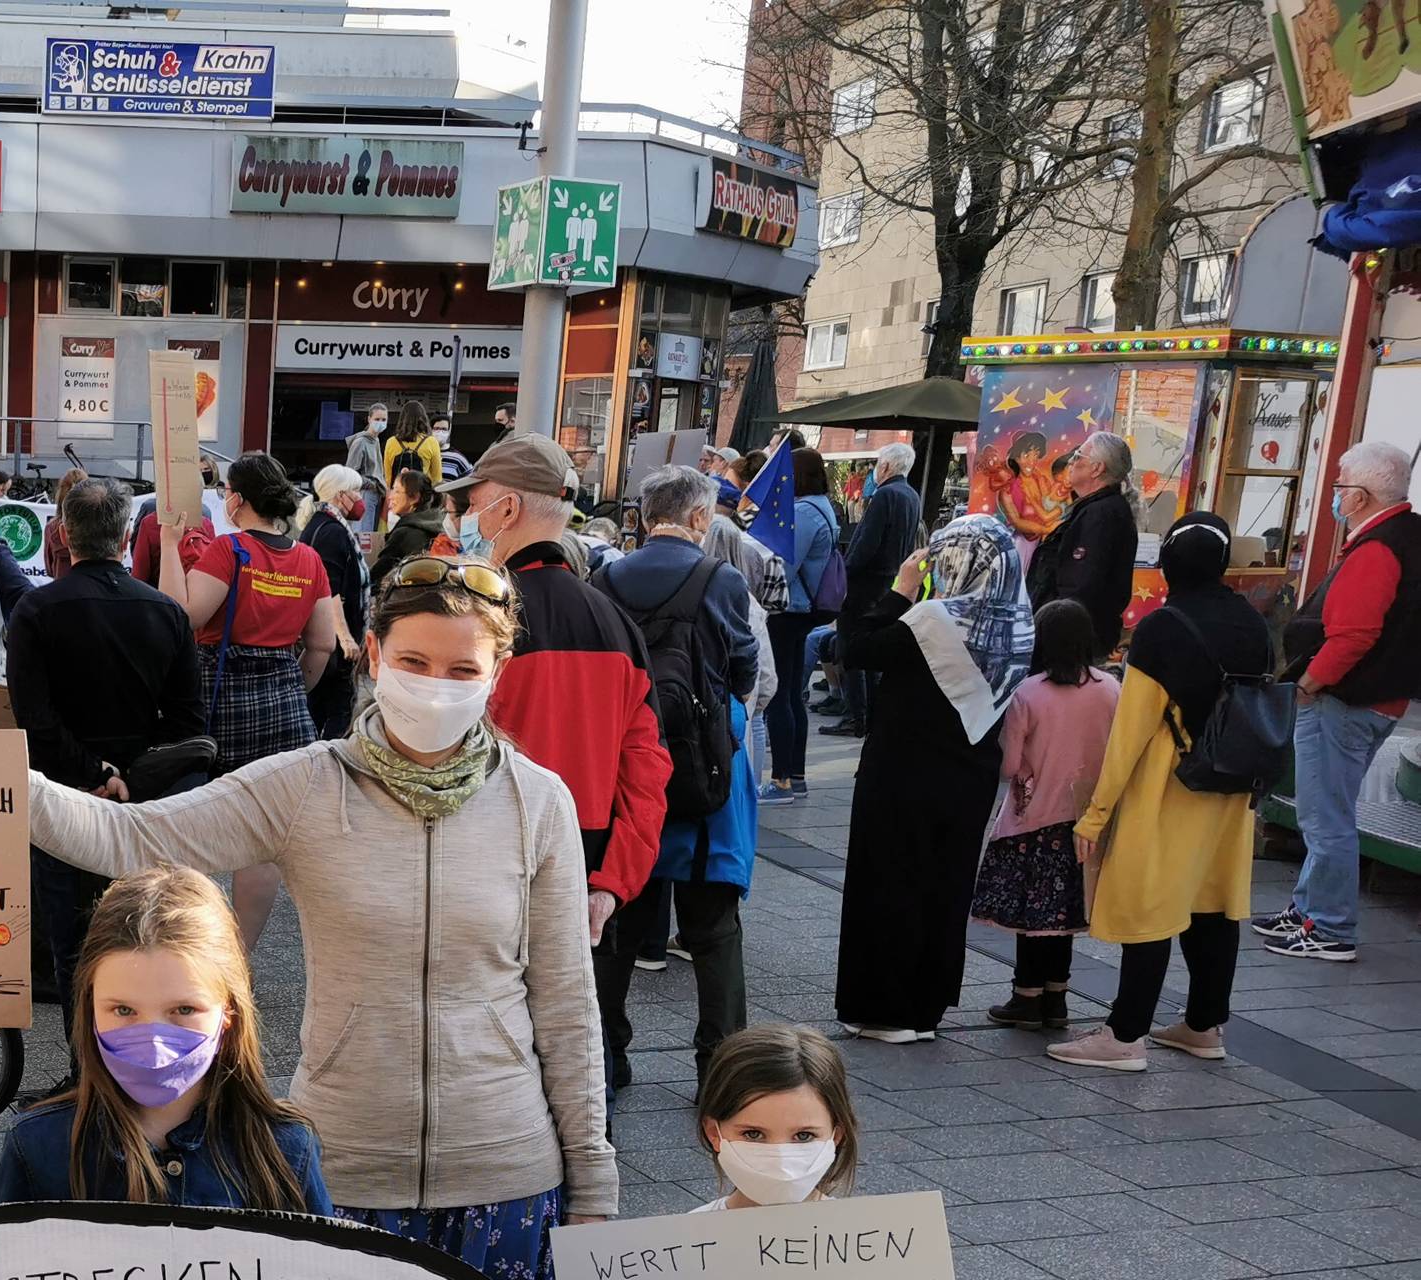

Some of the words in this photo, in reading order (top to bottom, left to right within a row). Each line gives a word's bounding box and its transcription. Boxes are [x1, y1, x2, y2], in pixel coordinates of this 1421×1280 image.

[92, 49, 156, 70] Schuh
[158, 51, 182, 78] &
[202, 50, 265, 70] Krahn
[91, 72, 252, 96] Schlüsseldienst
[123, 99, 180, 112] Gravuren
[182, 100, 194, 113] &
[196, 101, 248, 115] Stempel
[239, 145, 349, 207] Currywurst
[352, 149, 372, 196] &
[374, 150, 459, 198] Pommes
[353, 281, 429, 318] Curry
[69, 342, 96, 356] Curry
[295, 338, 403, 360] Currywurst
[410, 341, 424, 358] &
[64, 369, 110, 379] Currywurst
[64, 380, 71, 388] &
[73, 380, 109, 389] Pommes
[64, 399, 96, 413] 4,80
[1248, 392, 1292, 429] Kasse
